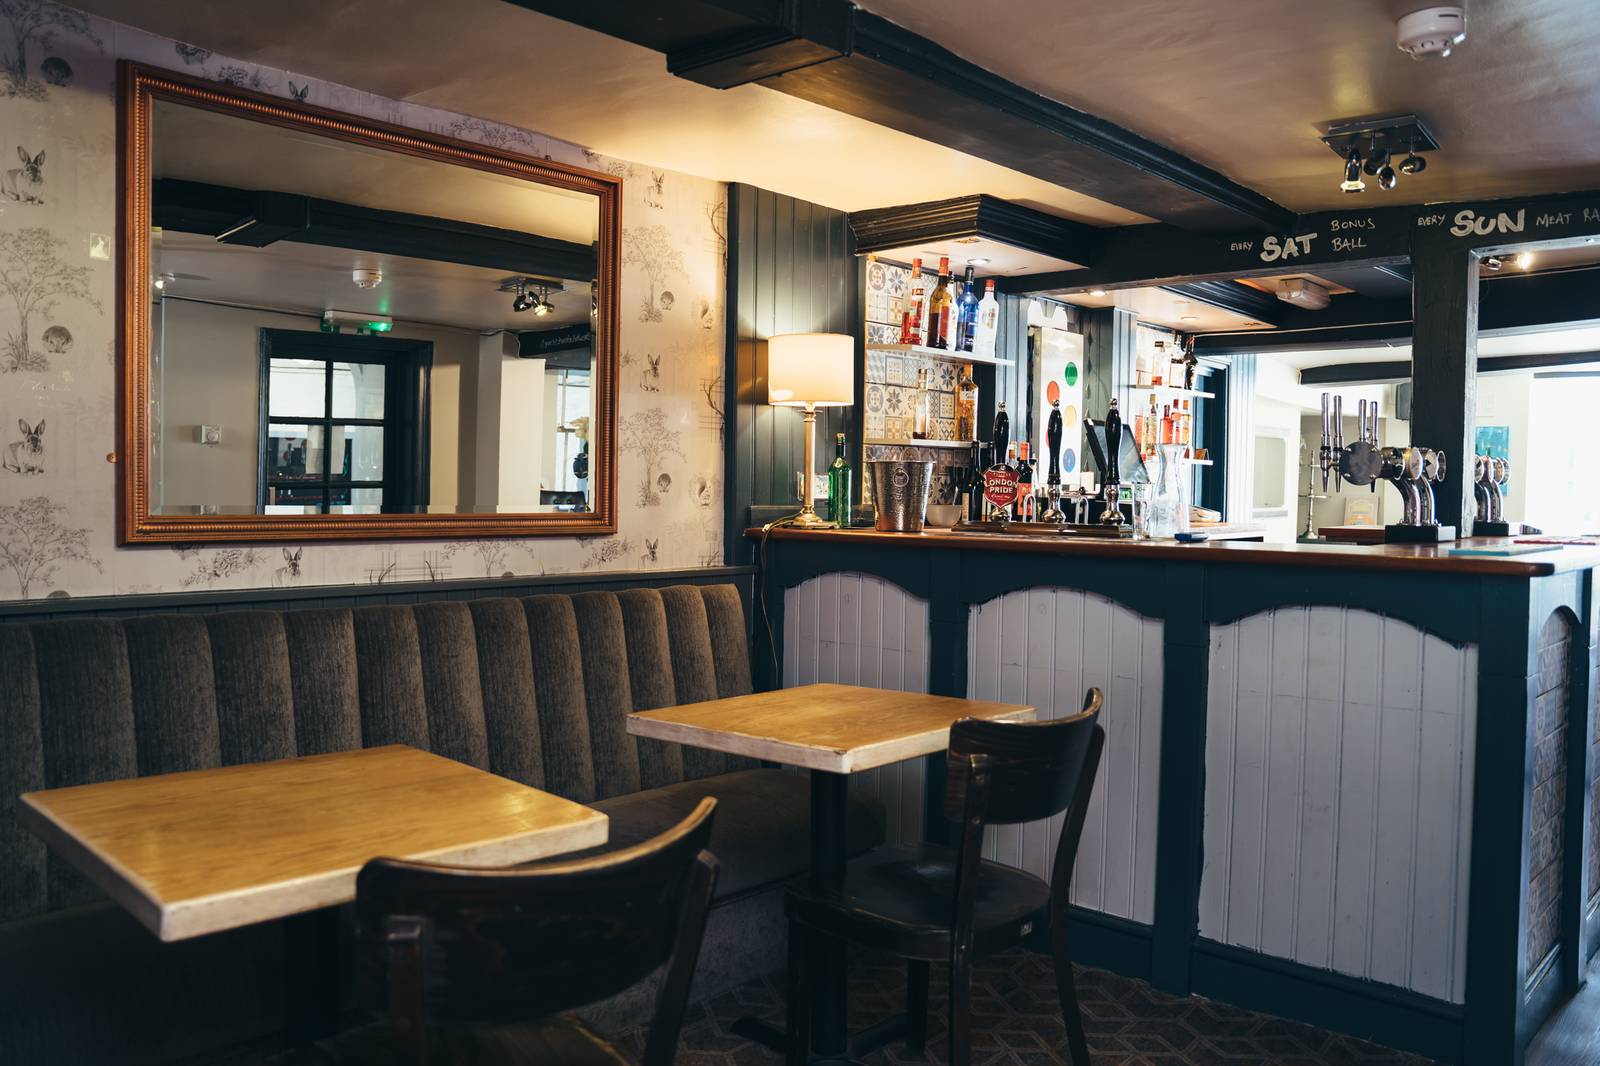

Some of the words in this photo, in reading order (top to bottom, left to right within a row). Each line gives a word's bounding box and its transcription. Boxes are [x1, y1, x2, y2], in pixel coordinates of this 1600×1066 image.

[1330, 218, 1376, 231] BONUS
[1417, 214, 1446, 226] EVERY
[1450, 208, 1526, 237] SUN
[1536, 213, 1572, 228] MEAT
[1260, 232, 1318, 262] SAT
[1331, 237, 1367, 251] BALL
[983, 479, 1019, 489] LONDON
